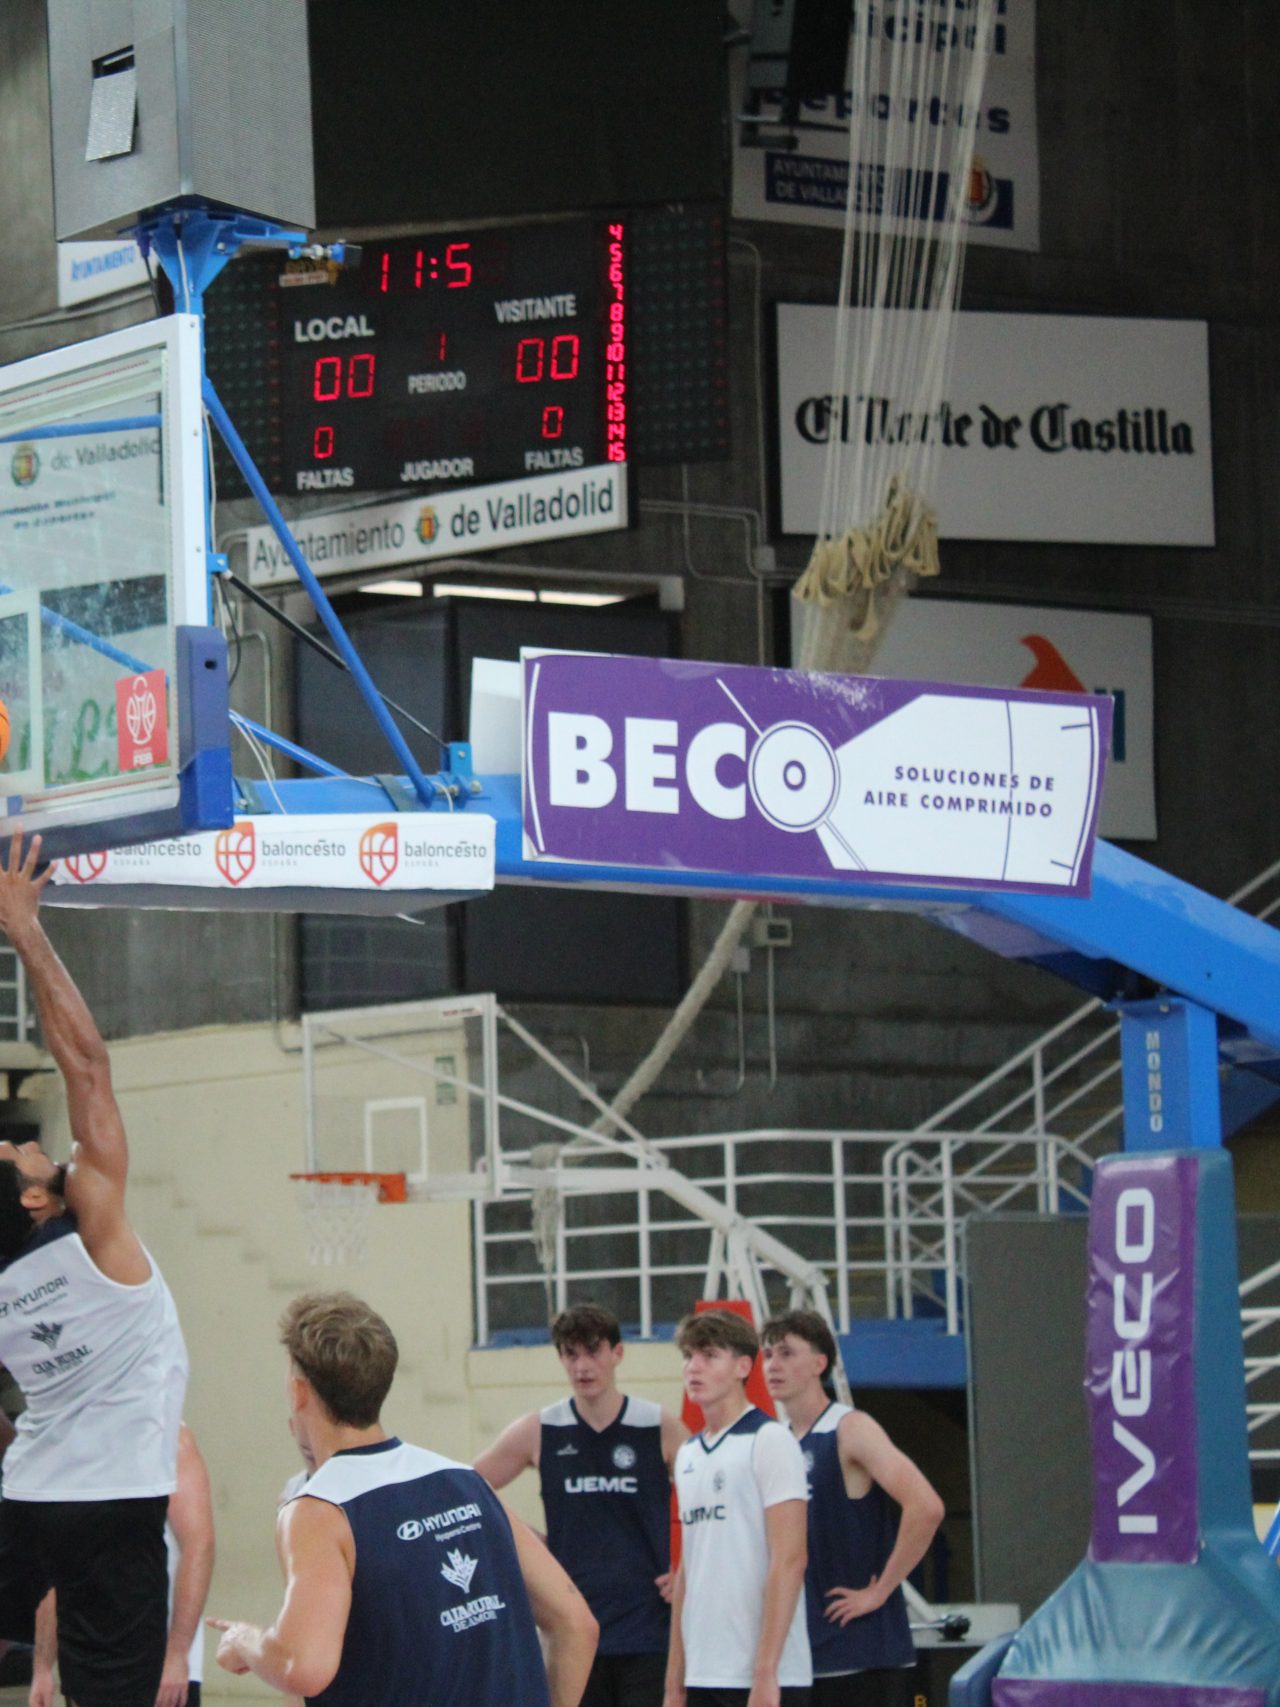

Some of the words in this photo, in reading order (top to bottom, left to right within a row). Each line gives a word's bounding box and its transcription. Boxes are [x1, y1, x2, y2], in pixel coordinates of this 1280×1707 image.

[494, 294, 577, 324] VISITANTE
[294, 314, 376, 343] LOCAL
[515, 334, 581, 383] 00
[312, 353, 376, 402] 00
[408, 371, 467, 395] PERIODO
[541, 405, 564, 439] 0
[979, 403, 1023, 450] de
[1030, 402, 1195, 456] Castilla
[312, 425, 334, 459] 0
[400, 457, 475, 483] JUGADOR
[525, 446, 584, 472] FALTAS
[296, 468, 355, 491] FALTAS
[451, 505, 480, 538] de
[487, 477, 614, 530] Valladolid
[547, 711, 840, 832] BECO
[894, 765, 1022, 790] SOLUCIONES
[1029, 774, 1055, 792] DE
[863, 789, 910, 809] AIRE
[919, 795, 1054, 818] COMPRIMIDO
[1145, 1030, 1163, 1134] MONDO
[11, 1275, 70, 1311] HYUNDAI
[1112, 1187, 1159, 1535] IVECO
[564, 1474, 638, 1494] UEMC
[422, 1503, 483, 1533] HYUNDAI
